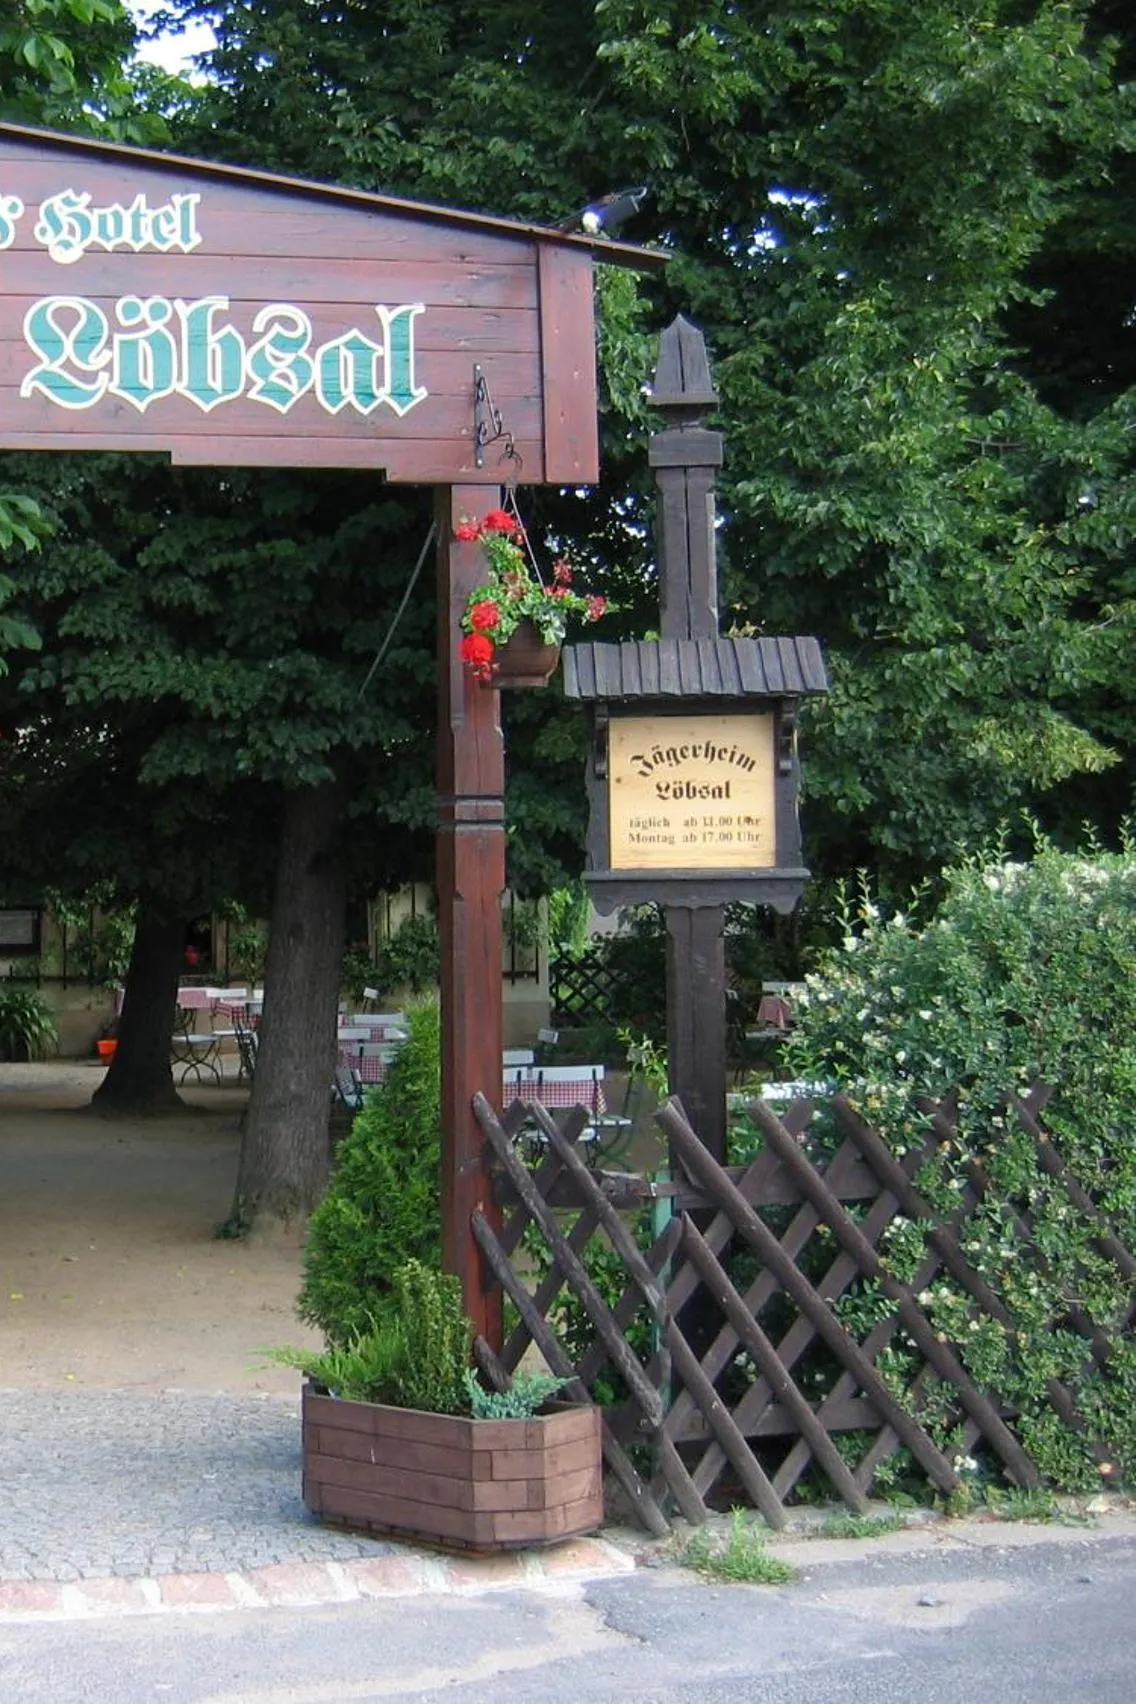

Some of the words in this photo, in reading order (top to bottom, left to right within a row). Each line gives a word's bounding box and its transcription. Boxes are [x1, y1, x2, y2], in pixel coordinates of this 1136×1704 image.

[35, 187, 202, 264] Hotel
[19, 295, 428, 417] Löbsal
[630, 740, 757, 777] Jägerheim
[655, 780, 731, 800] Löbsal
[629, 815, 671, 830] täglich
[683, 815, 698, 828] ab
[702, 815, 733, 828] 11.00
[737, 815, 761, 828] Uhr
[628, 832, 675, 846] Montag
[682, 831, 698, 844] ab
[702, 831, 733, 844] 17.00
[737, 831, 761, 844] Uhr
